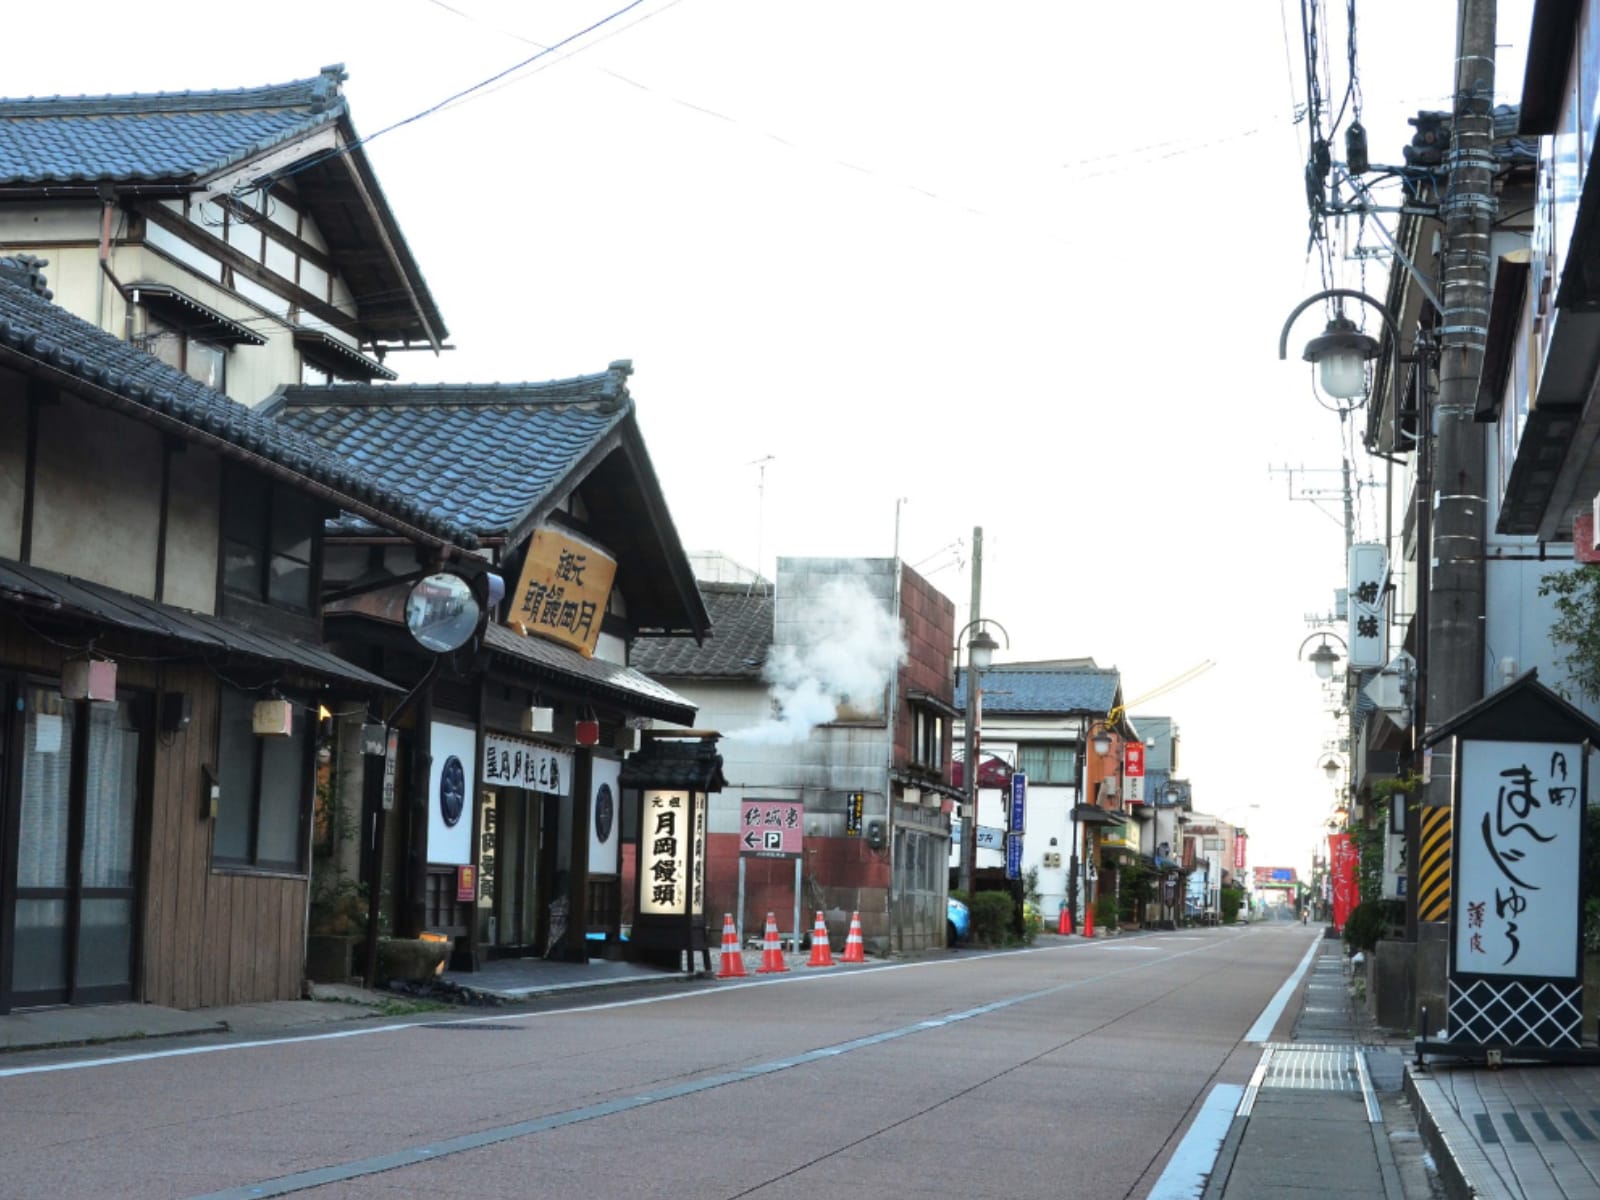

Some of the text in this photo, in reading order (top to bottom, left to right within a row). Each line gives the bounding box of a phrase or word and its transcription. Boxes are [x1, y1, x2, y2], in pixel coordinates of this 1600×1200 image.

[649, 811, 678, 906] 月岡饅頭
[767, 833, 779, 848] P
